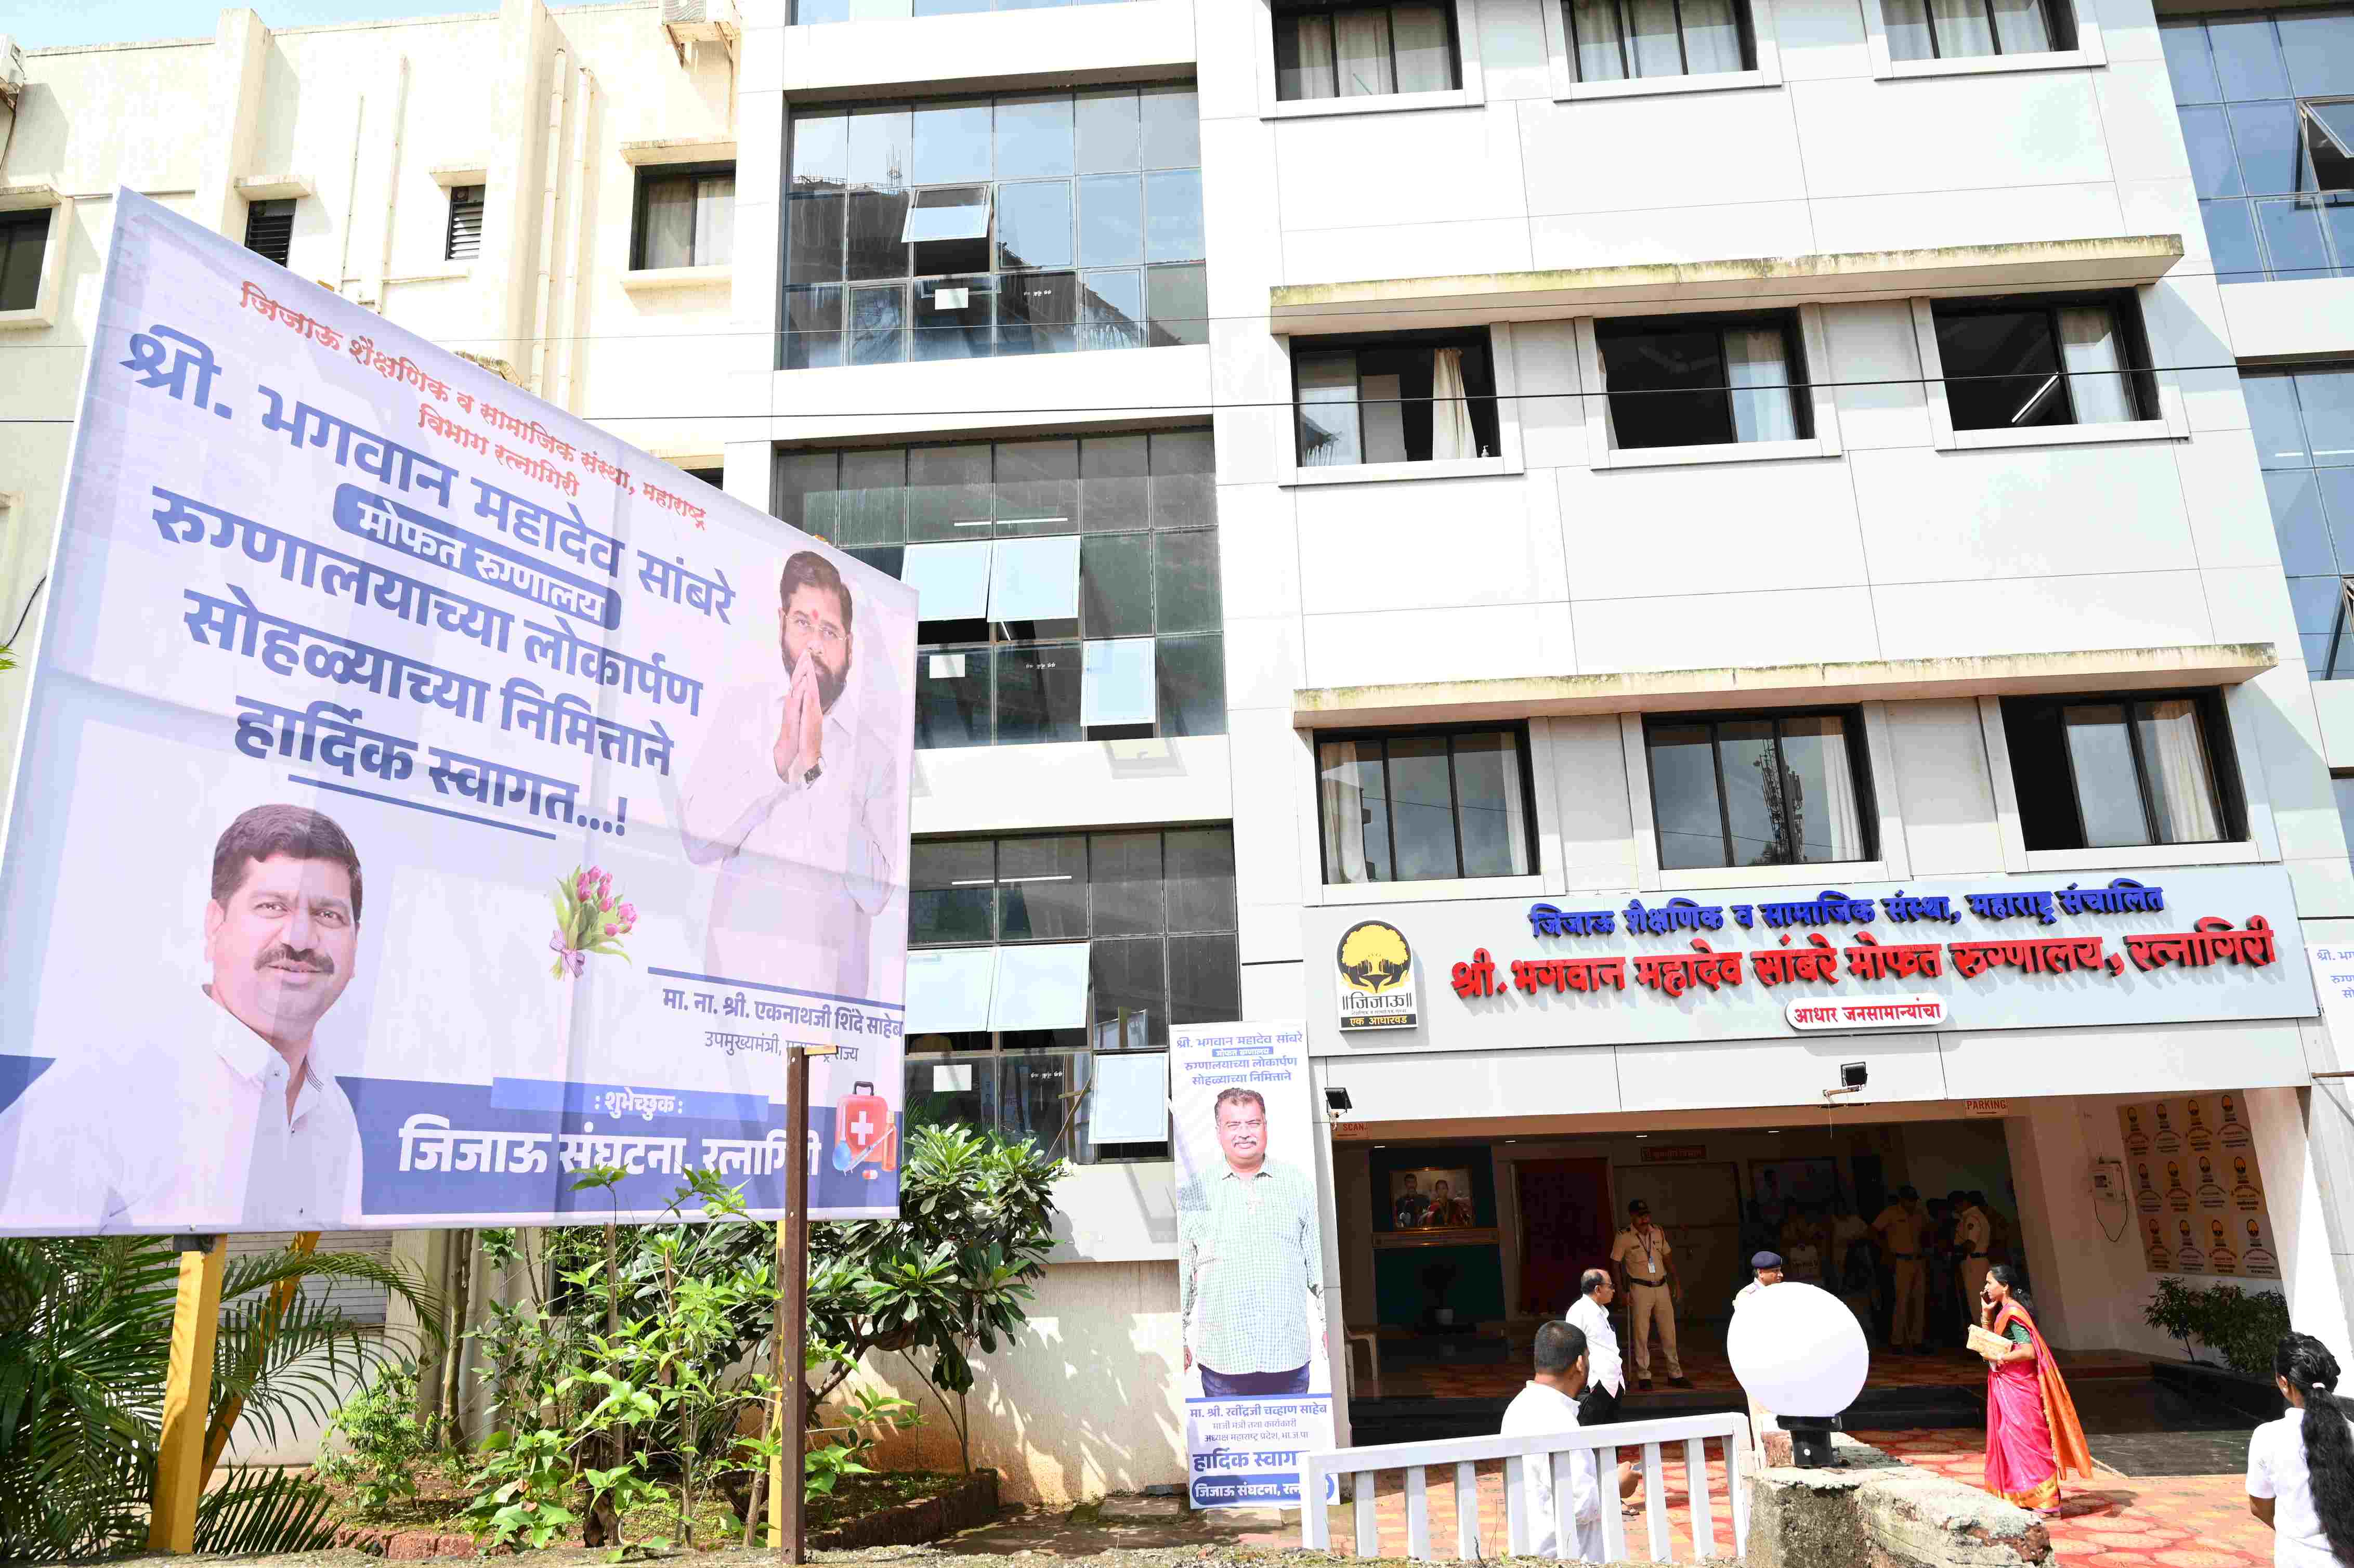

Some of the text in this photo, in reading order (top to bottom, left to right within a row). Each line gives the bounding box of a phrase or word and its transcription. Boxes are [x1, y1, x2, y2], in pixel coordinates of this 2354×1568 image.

[240, 281, 707, 530] जिजाऊ शैक्षणिक व सामाजिक संस्था, महाराष्ट्र
[421, 403, 580, 496] विभाग रत्नागिरी
[118, 324, 733, 622] श्री. भगवान महादेव सांबरे
[358, 500, 605, 621] मोफत रुग्णालय
[152, 486, 701, 715] रुग्णालयाच्या लोकार्पण
[184, 583, 674, 773] सोहळ्याच्या निमित्ताने
[236, 696, 417, 781] हार्दिक
[1527, 904, 1615, 937] जिजाऊ
[1621, 897, 1723, 935] शैक्षणिक
[1731, 904, 1754, 929] व
[1758, 890, 1876, 928] सामाजिक
[1965, 891, 2057, 923] महाराष्ट्र
[2055, 878, 2164, 914] संचालित
[1451, 914, 2276, 998] श्री. भगवान महादेव सांबरे मोफत रुग्णालय, रत्नागिरी
[663, 989, 904, 1038] मा. ना. श्री. एकनाथजी शिंदे साहेब
[1350, 1018, 1365, 1026] एक
[1794, 998, 1941, 1023] आधार जनसामान्यांचा
[705, 1032, 781, 1056] उपमुख्यमंत्री,
[1177, 1031, 1302, 1048] श्री. भगवान महादेव सांबरे
[1184, 1055, 1298, 1070] रुग्णालयाच्या लोकार्पण
[1192, 1070, 1291, 1086] सोहळ्याच्या निमित्ताने
[1967, 1100, 2006, 1110] PARKING
[399, 1114, 552, 1173] जिजाऊ
[1343, 1123, 1364, 1131] SCAN
[1190, 1402, 1327, 1417] मा. श्री. रवींद्रजी चव्हाण साहेब
[1193, 1447, 1310, 1472] हार्दिक स्वाग
[1195, 1483, 1235, 1497] जिजाऊ
